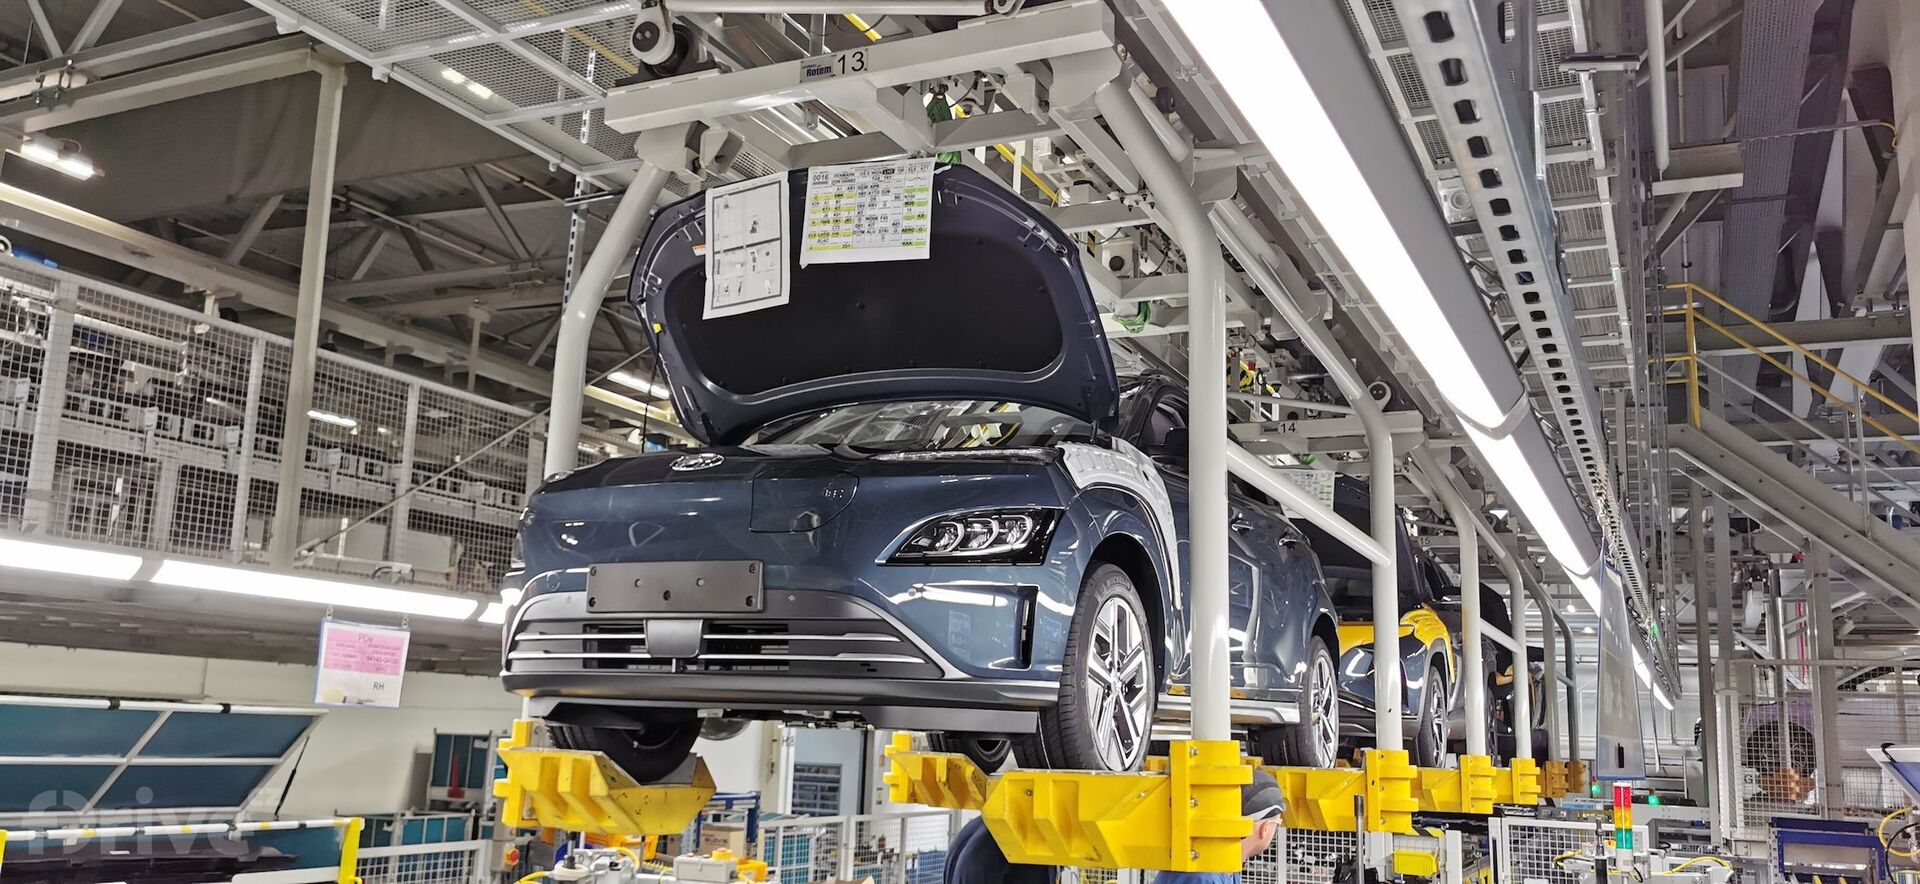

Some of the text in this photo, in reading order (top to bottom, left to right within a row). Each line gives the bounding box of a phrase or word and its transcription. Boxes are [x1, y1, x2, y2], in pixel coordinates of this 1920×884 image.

[806, 51, 865, 77] Rotem 13
[1281, 423, 1296, 433] 14
[373, 681, 385, 691] RH
